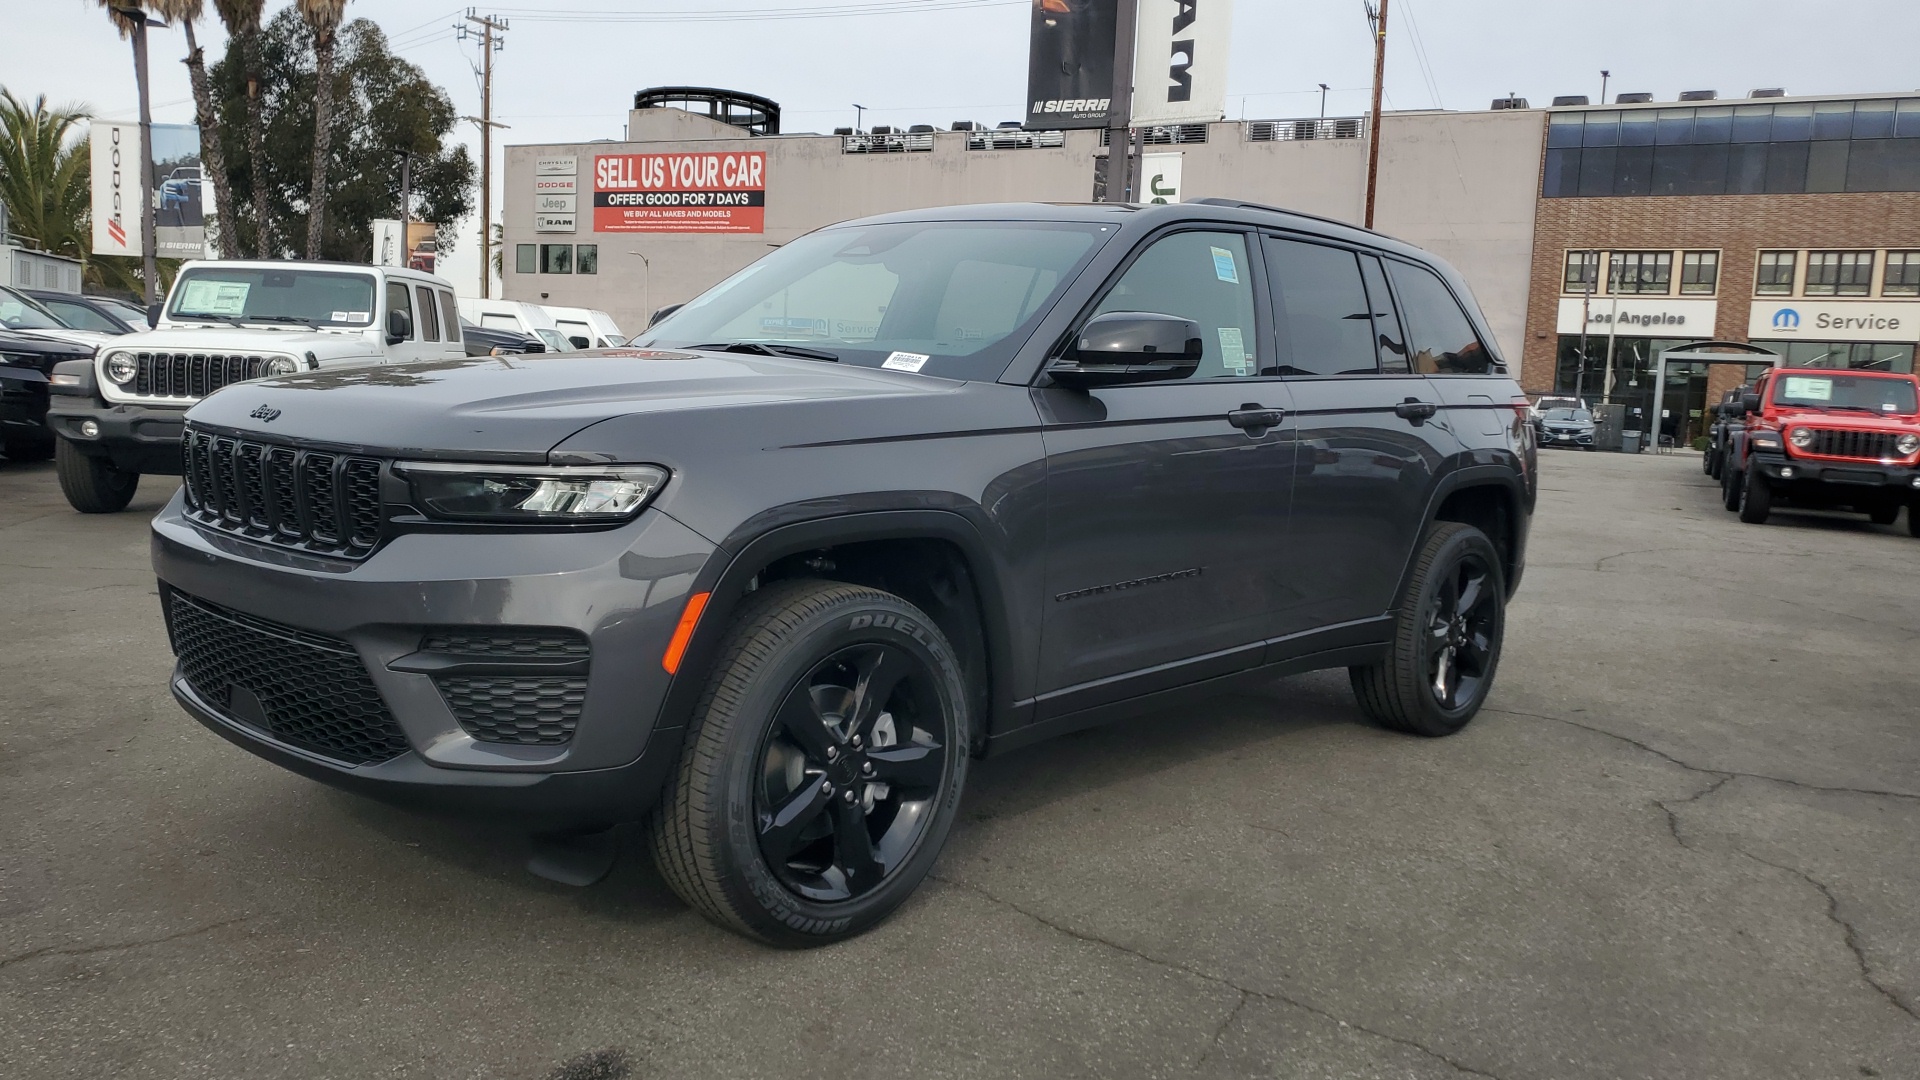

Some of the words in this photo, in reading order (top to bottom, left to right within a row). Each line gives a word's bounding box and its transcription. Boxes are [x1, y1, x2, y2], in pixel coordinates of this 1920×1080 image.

[1044, 99, 1111, 112] SIERRA
[112, 127, 122, 229] DODGE
[596, 157, 638, 189] SELL
[641, 156, 665, 188] US
[668, 155, 719, 188] YOUR
[722, 154, 763, 187] CAR
[542, 197, 567, 210] Jeep
[608, 193, 644, 205] OFFER
[645, 193, 680, 205] GOOD
[682, 193, 706, 205] FOR
[707, 193, 714, 205] 7
[716, 192, 749, 205] DAYS
[623, 210, 635, 218] WE
[635, 210, 649, 218] BUY
[649, 210, 662, 218] ALL
[662, 210, 686, 218] MAKES
[687, 210, 702, 218] AND
[702, 210, 731, 218] MODELS
[166, 241, 202, 250] SIERRA
[1587, 311, 1613, 324] Los
[1617, 311, 1686, 327] Angeles
[1816, 313, 1900, 330] Service
[250, 403, 282, 423] Jeep
